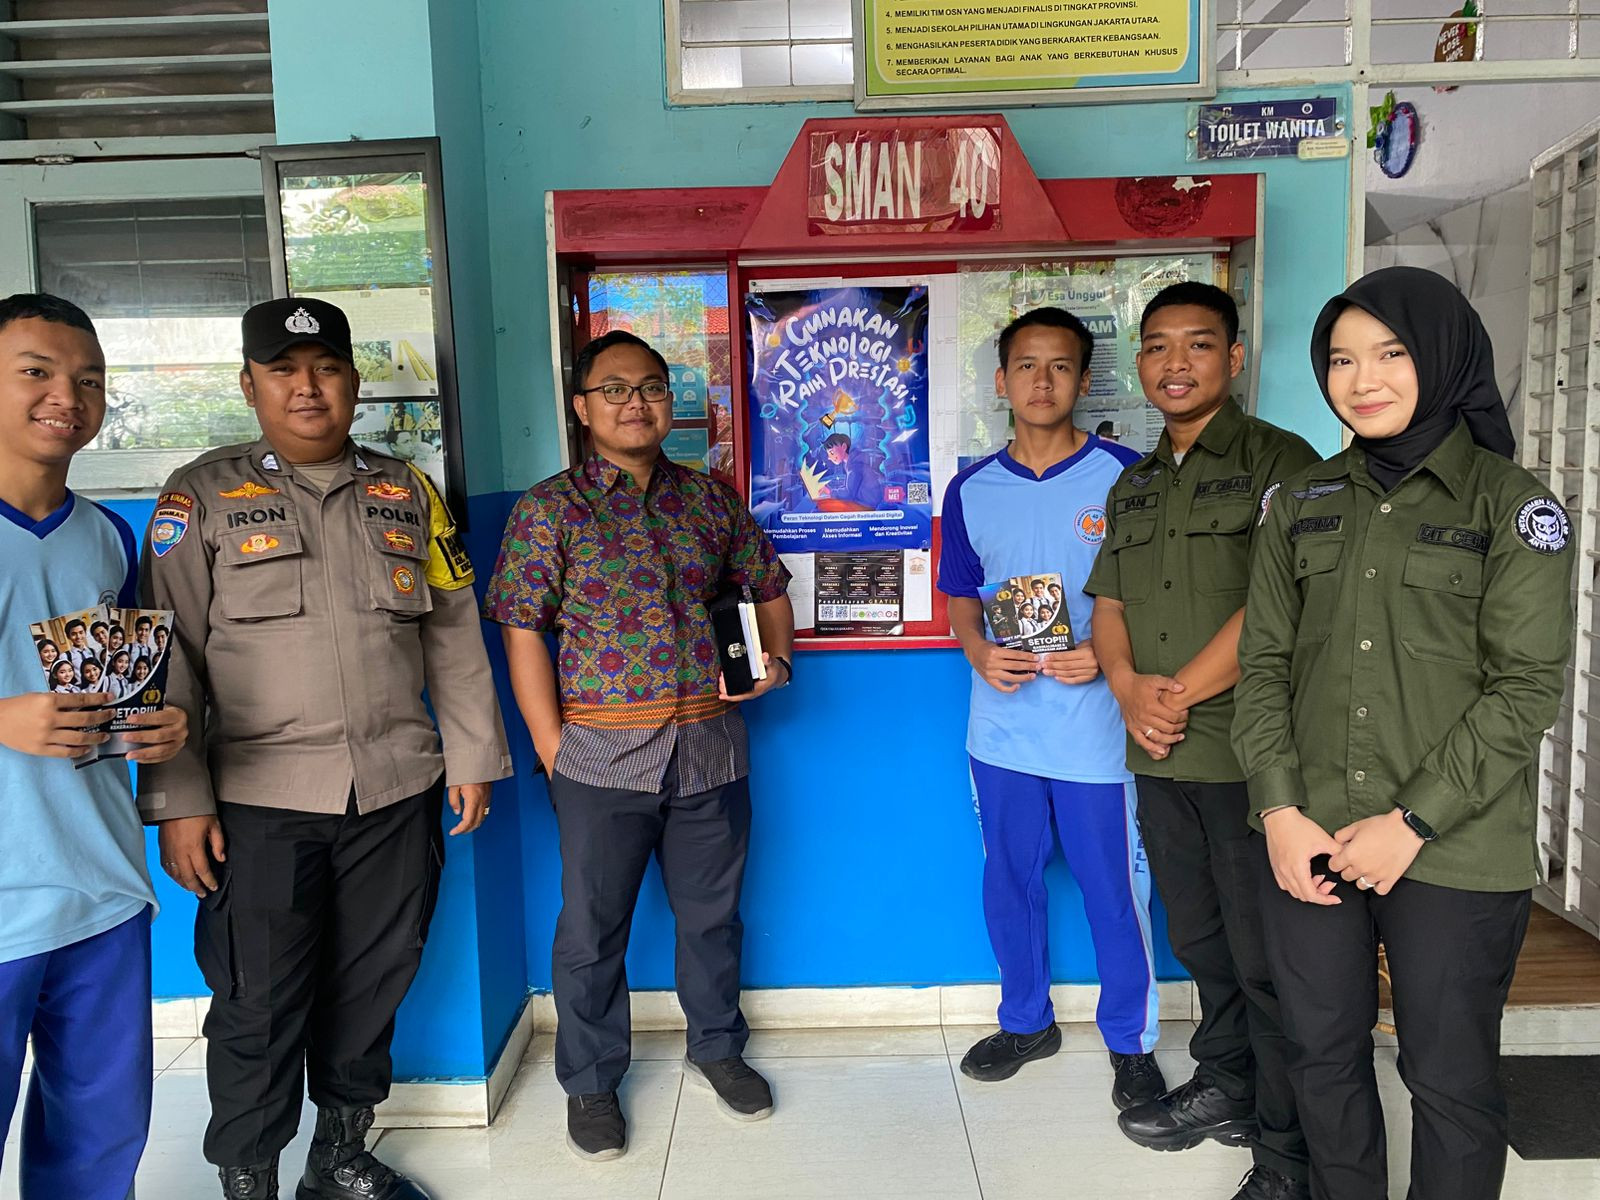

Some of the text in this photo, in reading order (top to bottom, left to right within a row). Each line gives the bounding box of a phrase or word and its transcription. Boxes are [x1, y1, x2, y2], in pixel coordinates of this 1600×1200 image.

[886, 0, 1138, 18] 4. MEMILIKI TIM OSN YANG MENJADI FINALIS DI TINGKAT PROVINSI.
[895, 25, 930, 34] MENJADI
[931, 24, 968, 33] SEKOLAH
[970, 23, 1000, 31] PILIHAN
[1002, 22, 1030, 30] UTAMA
[1030, 21, 1039, 29] DI
[1040, 18, 1092, 28] LINGKUNGAN
[1094, 17, 1130, 26] JAKARTA
[1131, 16, 1160, 24] UTARA.
[895, 41, 958, 50] MENGHASILKAN
[960, 40, 996, 48] PESERTA
[1019, 37, 1040, 46] YANG
[1042, 35, 1102, 44] BERKARAKTER
[1103, 33, 1161, 42] KEBANGSAAN.
[1442, 36, 1461, 54] LOSE
[896, 58, 949, 66] MEMBERIKAN
[954, 56, 990, 64] LAYANAN
[1020, 54, 1042, 62] ANAK
[1047, 52, 1069, 60] YANG
[1074, 50, 1140, 60] BERKEBUTUHAN
[1145, 48, 1178, 56] KHUSUS
[896, 67, 966, 76] SECARA OPTIMAL.
[1261, 106, 1274, 117] KM
[1208, 119, 1326, 142] TOILET WANITA
[824, 140, 987, 222] SMAN 40
[1048, 290, 1106, 302] Esa Unggul
[786, 306, 900, 346] GUNAKAN
[774, 332, 892, 380] TEKNOLOGI
[778, 357, 910, 408] RAIH PRESTASI
[227, 507, 286, 529] IRON
[366, 505, 420, 527] POLRI
[1518, 498, 1545, 534] DETASEMEN
[1528, 537, 1546, 550] ANTI
[1028, 636, 1068, 646] SETOP!!!
